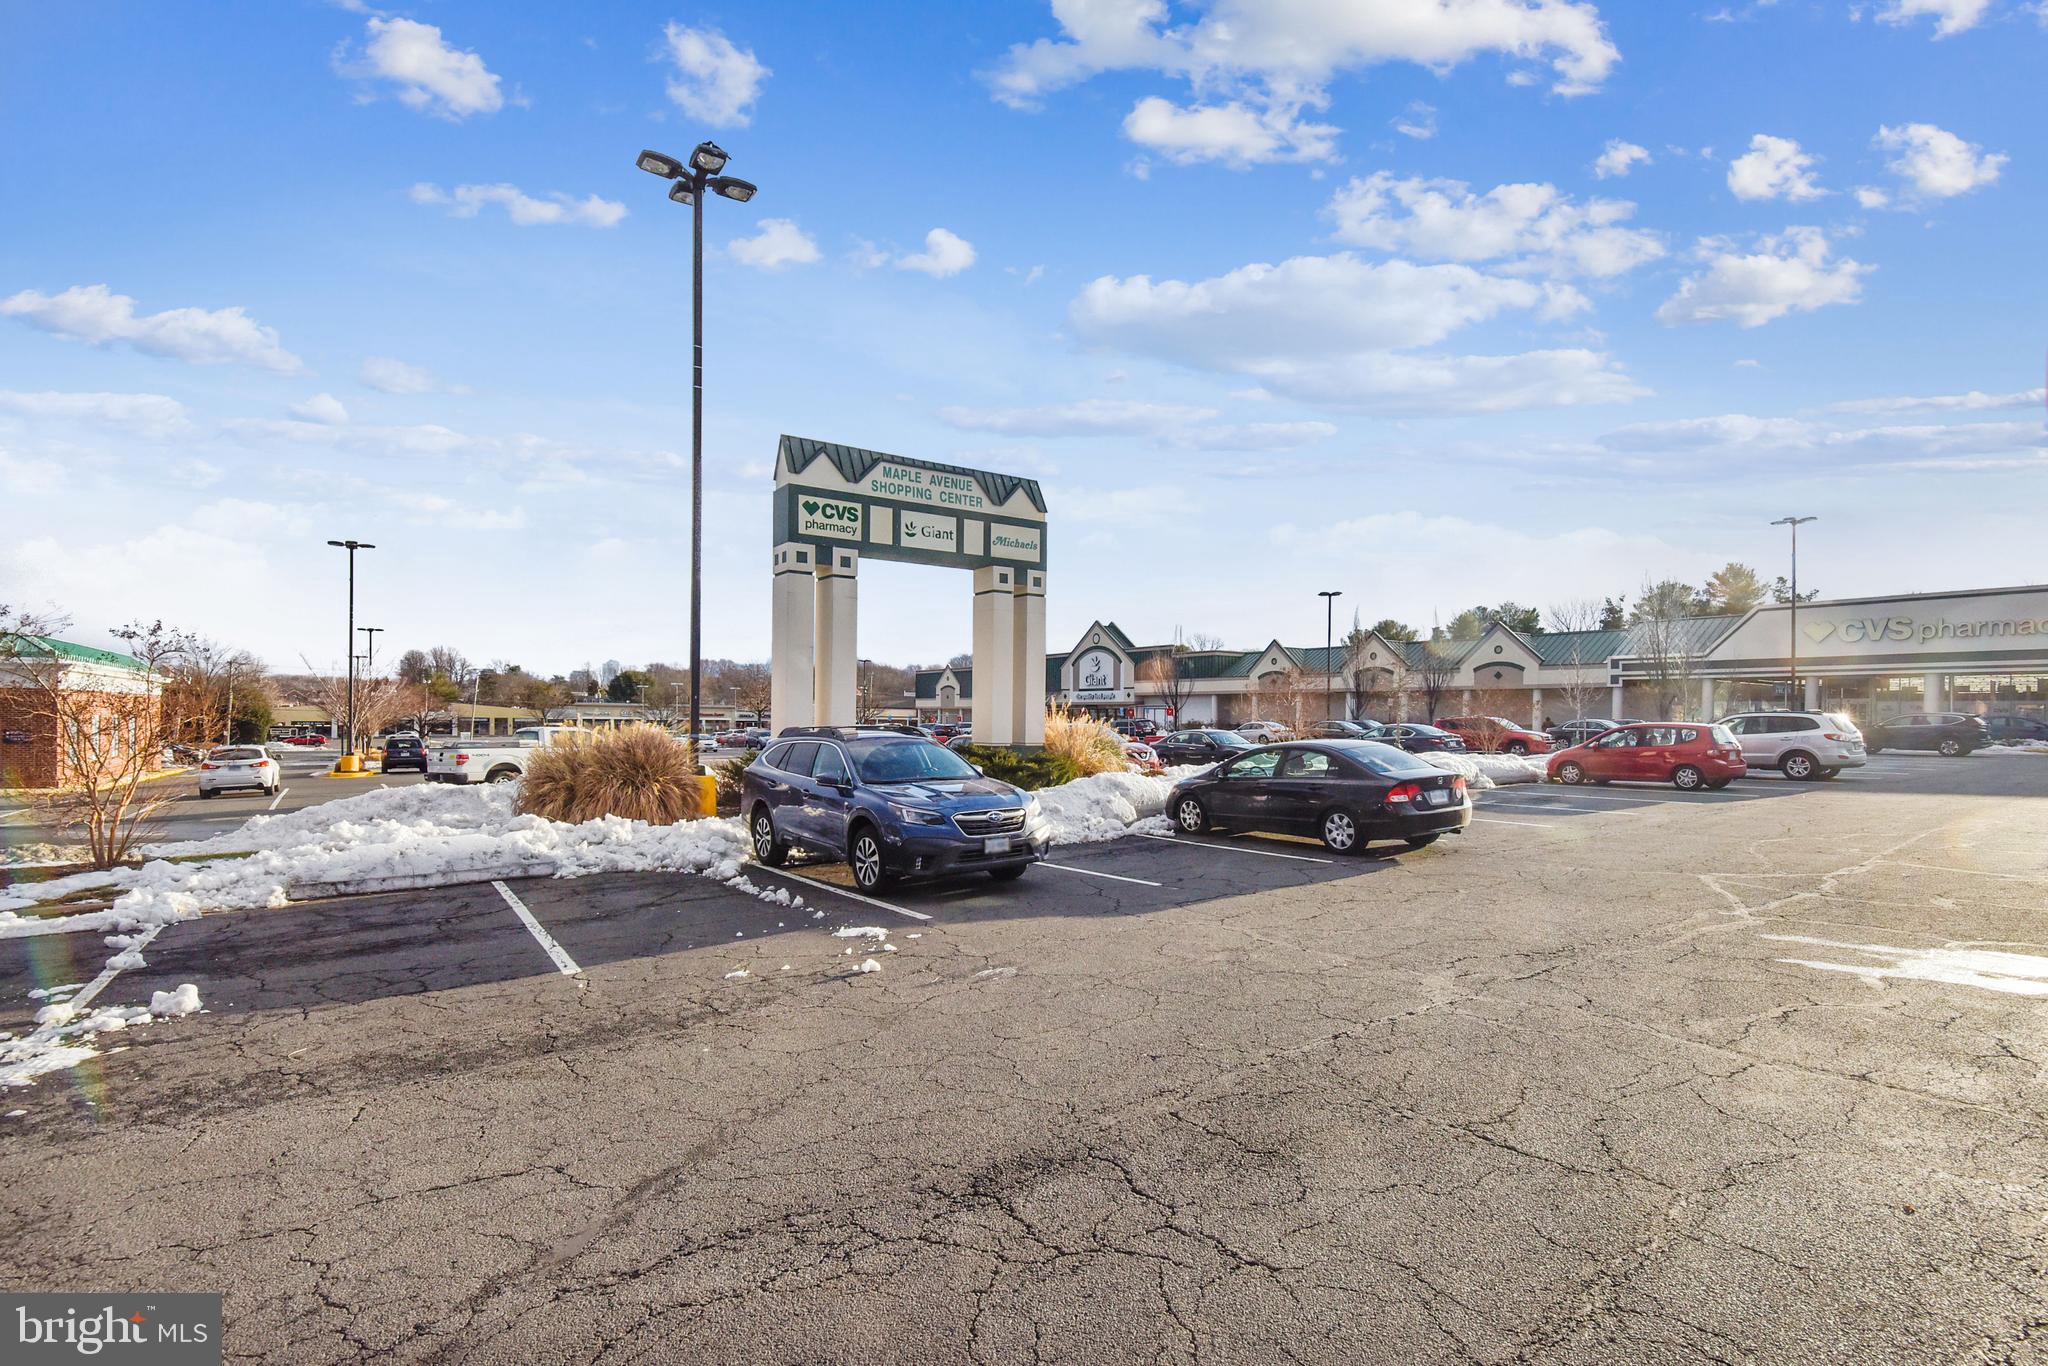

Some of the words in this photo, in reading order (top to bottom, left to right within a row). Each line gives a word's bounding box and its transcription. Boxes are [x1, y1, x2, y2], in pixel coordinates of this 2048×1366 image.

[883, 466, 922, 484] MAPLE
[929, 474, 973, 492] AVENUE
[871, 480, 933, 501] SHOPPING
[939, 491, 983, 508] CENTER
[821, 503, 859, 523] CVS
[805, 519, 858, 536] pharmacy
[921, 525, 954, 541] Giant
[992, 535, 1038, 551] Michaels
[1837, 616, 1914, 643] CVS
